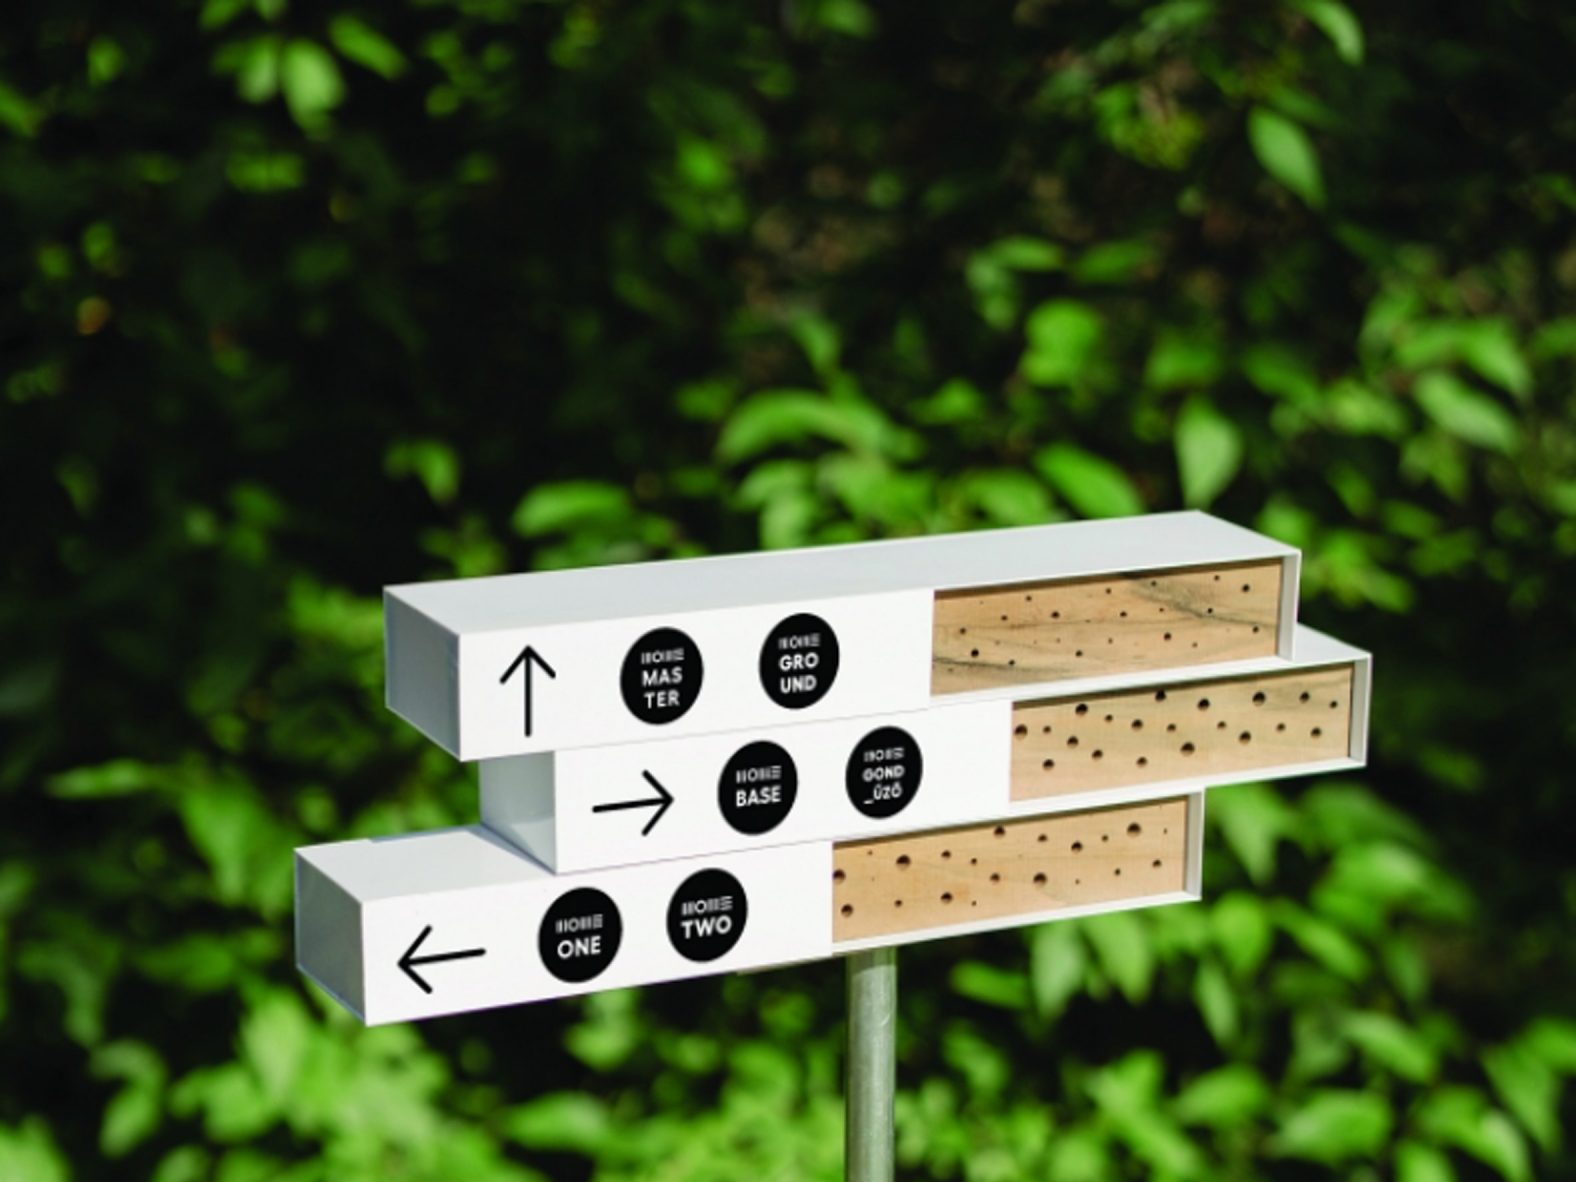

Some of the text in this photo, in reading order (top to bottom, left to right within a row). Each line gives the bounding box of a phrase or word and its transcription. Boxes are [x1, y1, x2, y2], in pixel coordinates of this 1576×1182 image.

[778, 652, 819, 672] GRO
[642, 667, 683, 687] MAS
[780, 674, 817, 694] UND
[644, 690, 680, 709] TER
[862, 764, 905, 782] GOND
[736, 785, 782, 808] BASE
[681, 915, 733, 939] TWO
[557, 935, 601, 959] ONE
